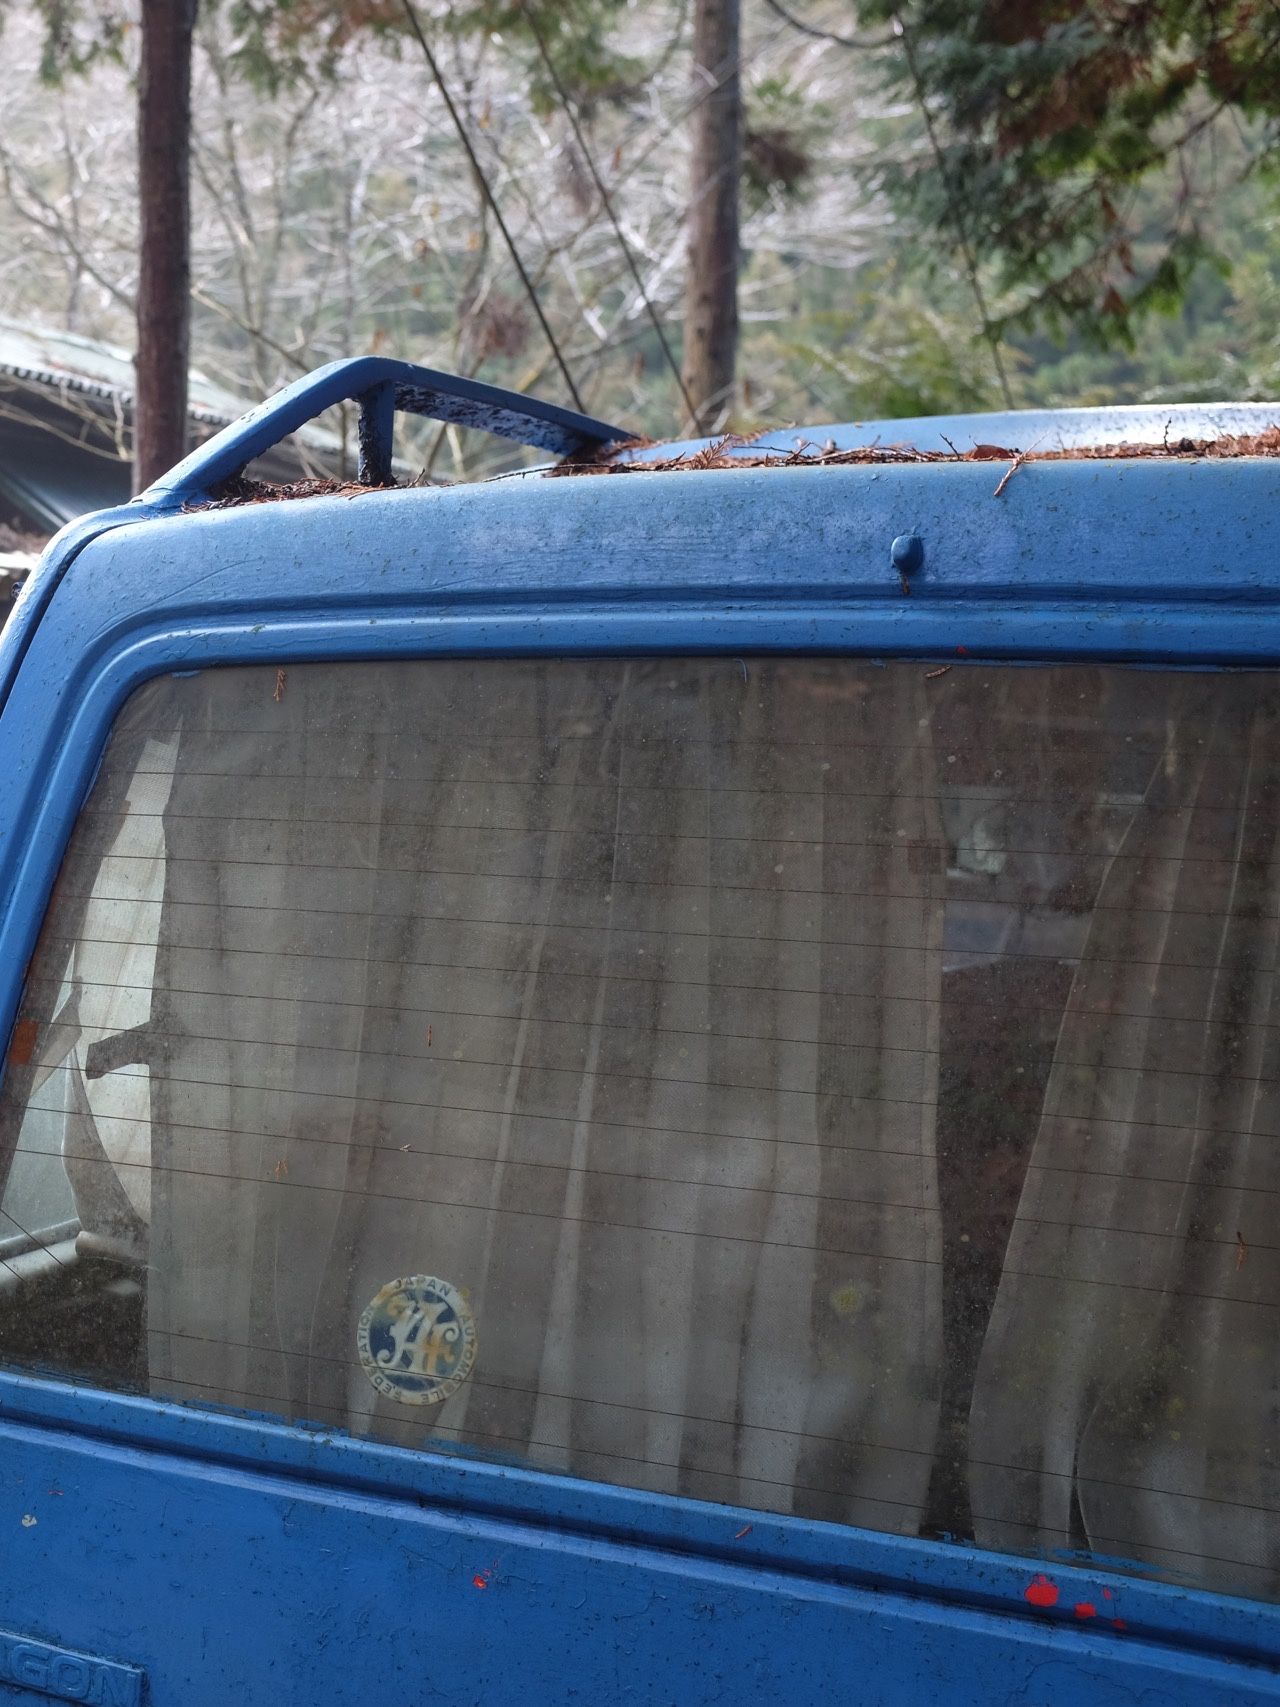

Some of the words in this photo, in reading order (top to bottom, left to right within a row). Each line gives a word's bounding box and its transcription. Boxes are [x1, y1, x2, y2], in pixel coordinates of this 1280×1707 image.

[396, 1277, 452, 1297] JAPAN
[358, 1307, 402, 1400] FEDERATION
[420, 1315, 476, 1403] AUTOMOBILE
